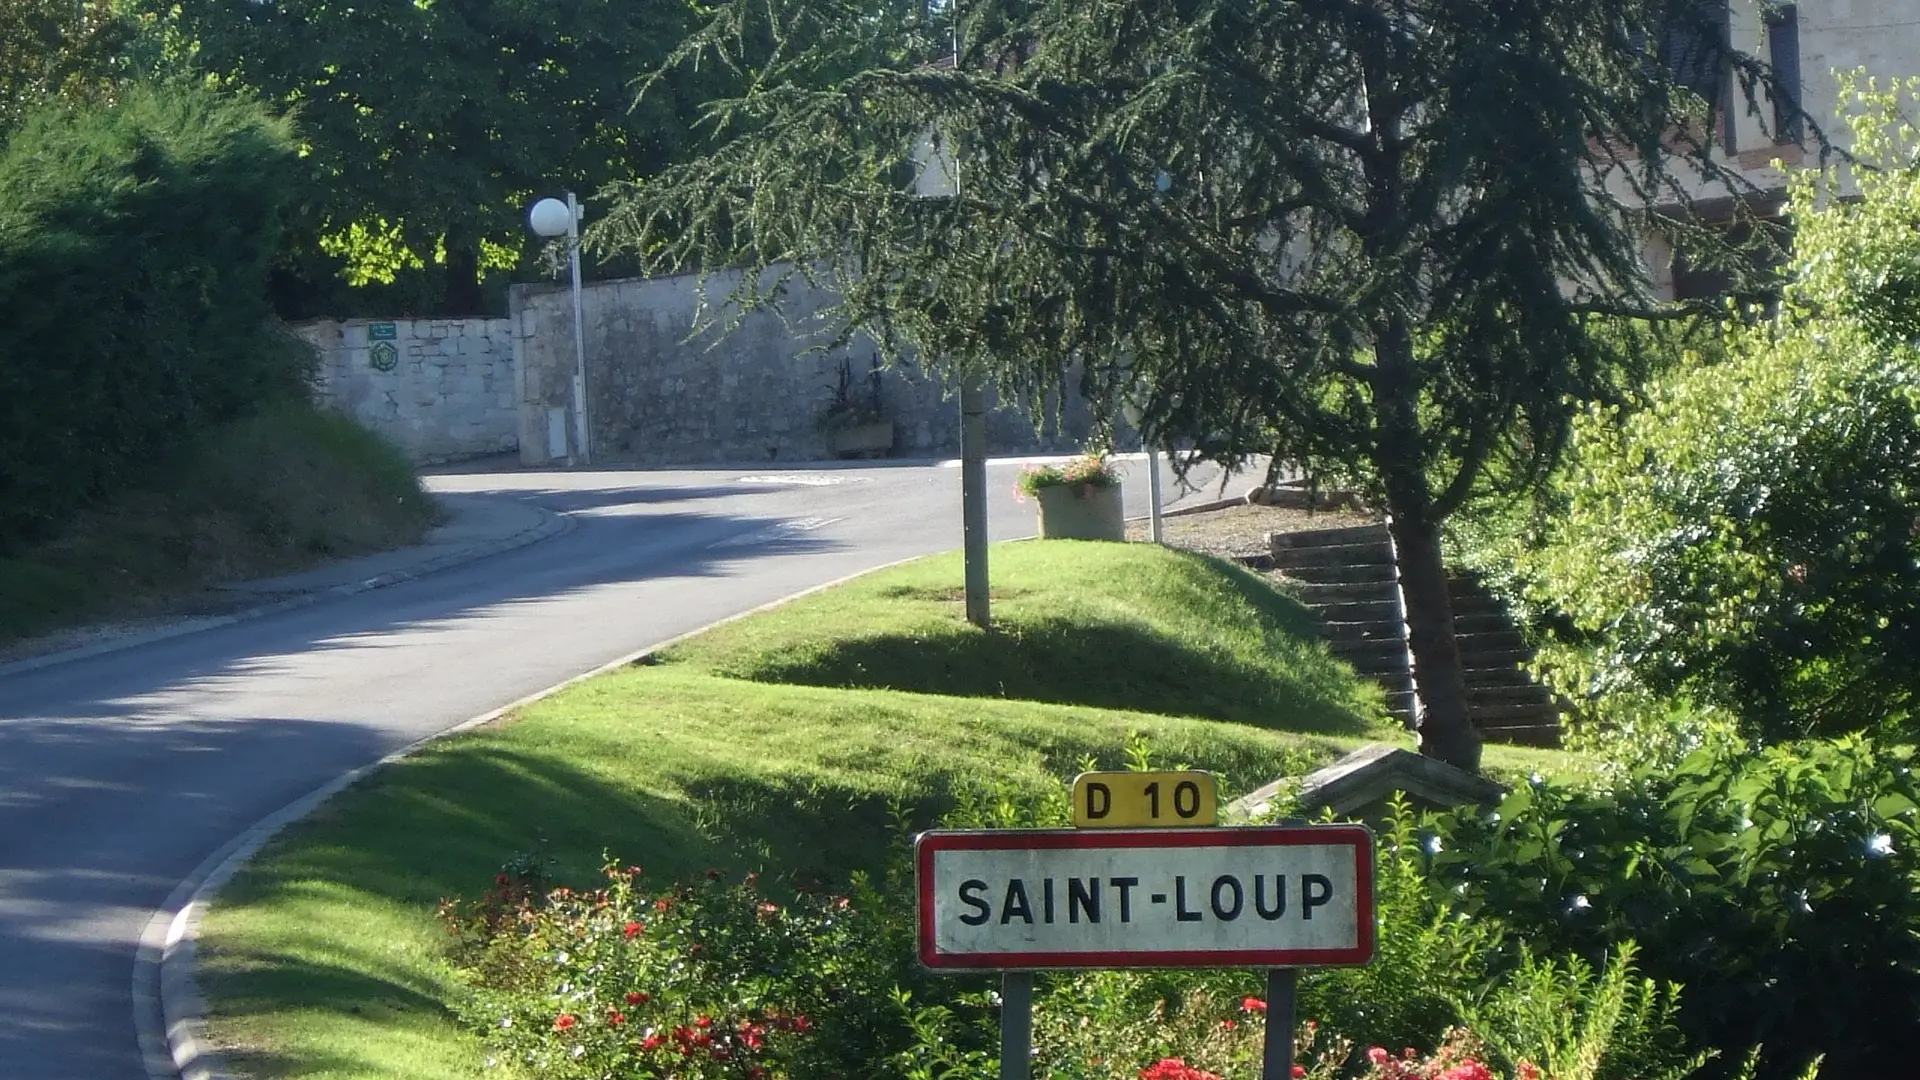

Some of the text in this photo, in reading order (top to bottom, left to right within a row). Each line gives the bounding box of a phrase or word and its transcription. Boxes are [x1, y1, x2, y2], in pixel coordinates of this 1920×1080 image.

[1086, 780, 1200, 819] D 10
[958, 873, 1333, 927] SAINT-LOUP
